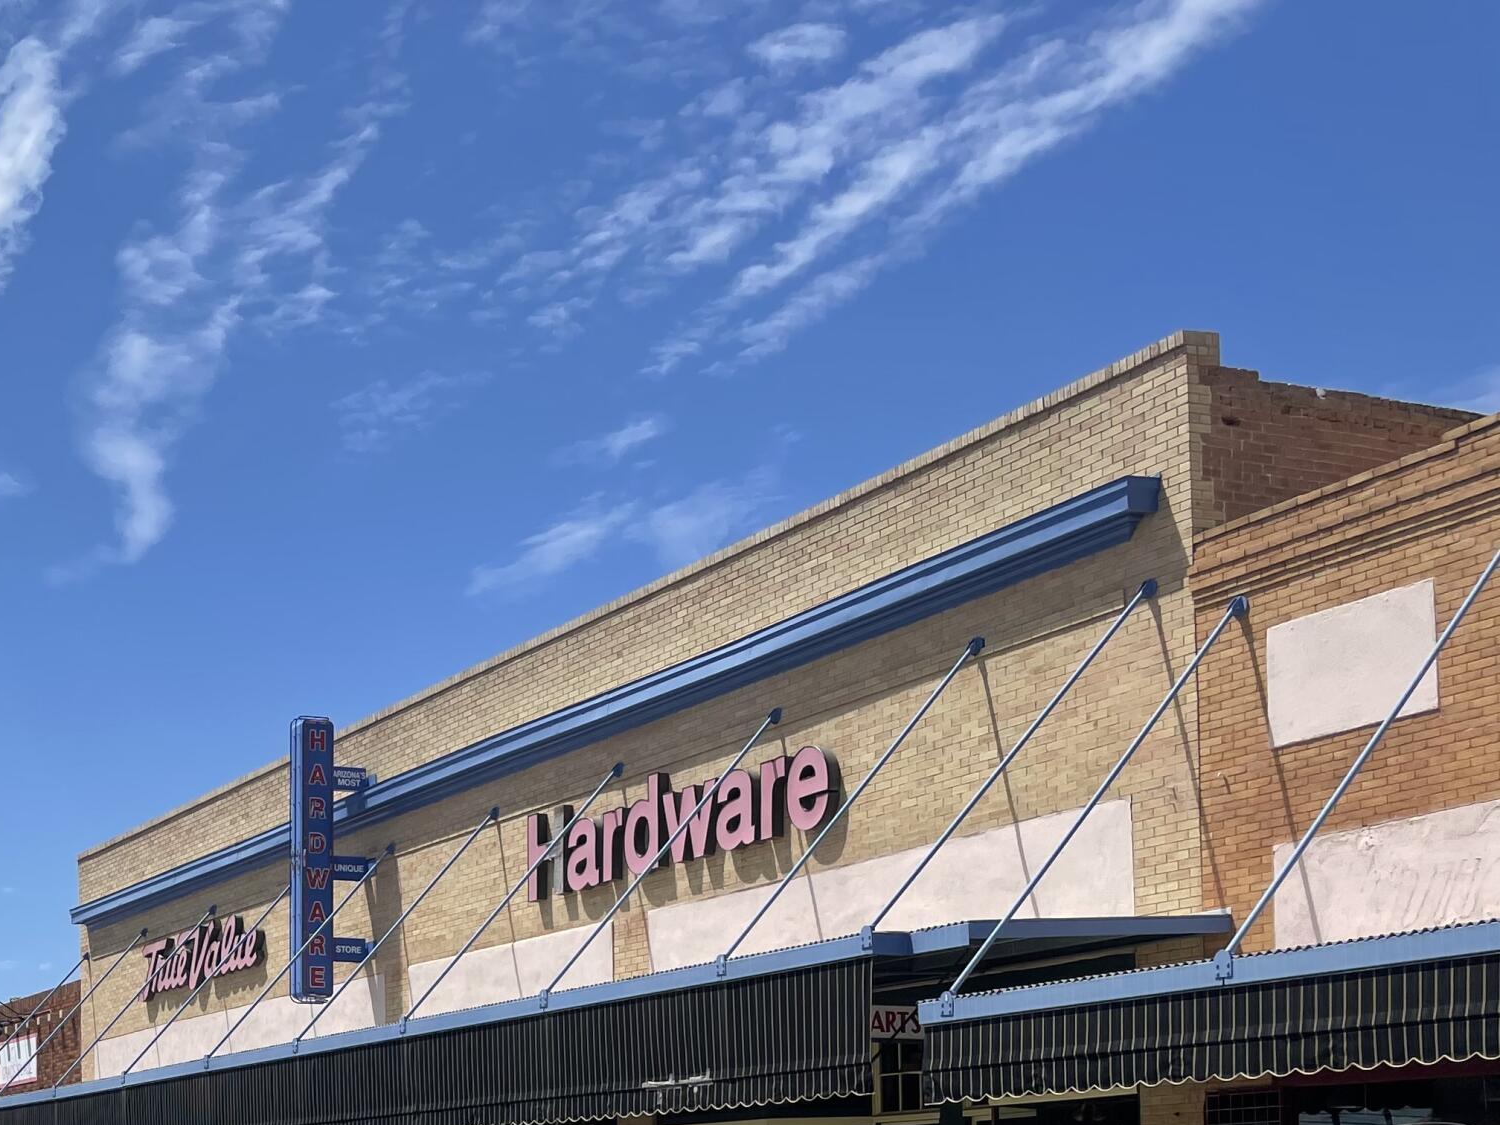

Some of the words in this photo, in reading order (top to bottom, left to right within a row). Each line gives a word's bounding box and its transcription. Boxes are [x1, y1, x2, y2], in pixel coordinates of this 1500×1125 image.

[333, 769, 366, 780] ARIZONA'S
[337, 778, 361, 787] MOST
[527, 745, 831, 902] Hardware
[306, 729, 330, 989] HARDWARE
[334, 863, 364, 873] UNIQUE
[335, 944, 362, 955] STORE
[138, 939, 188, 1001] True
[177, 914, 258, 990] Value
